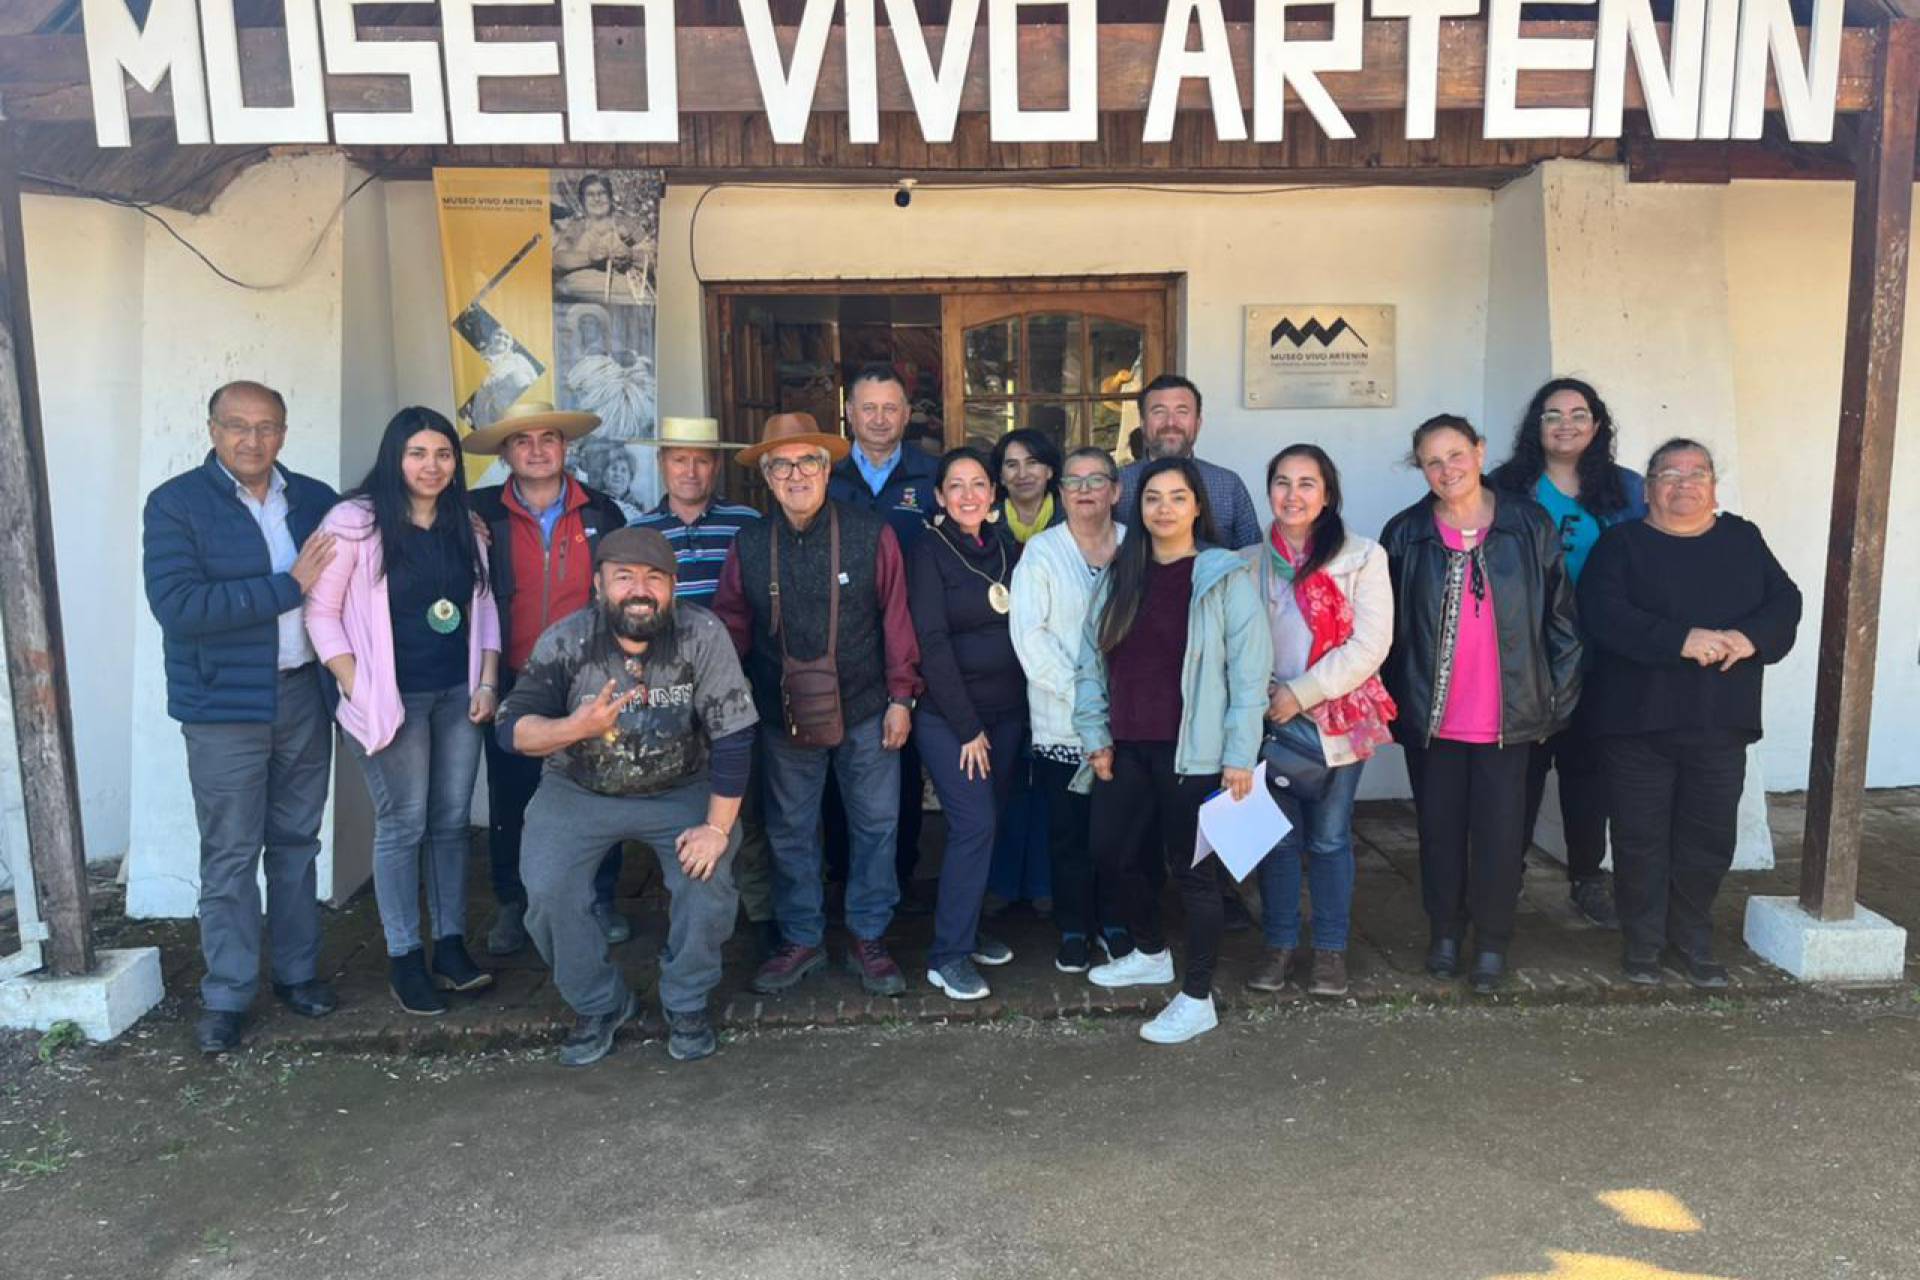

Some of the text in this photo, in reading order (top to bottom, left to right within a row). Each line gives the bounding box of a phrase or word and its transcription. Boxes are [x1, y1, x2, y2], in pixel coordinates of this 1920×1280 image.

[82, 0, 1846, 147] MUSEO VIVO ARTENIN
[442, 197, 476, 205] MUSEO
[1270, 352, 1369, 361] MUSEO VIVO ARTENIN
